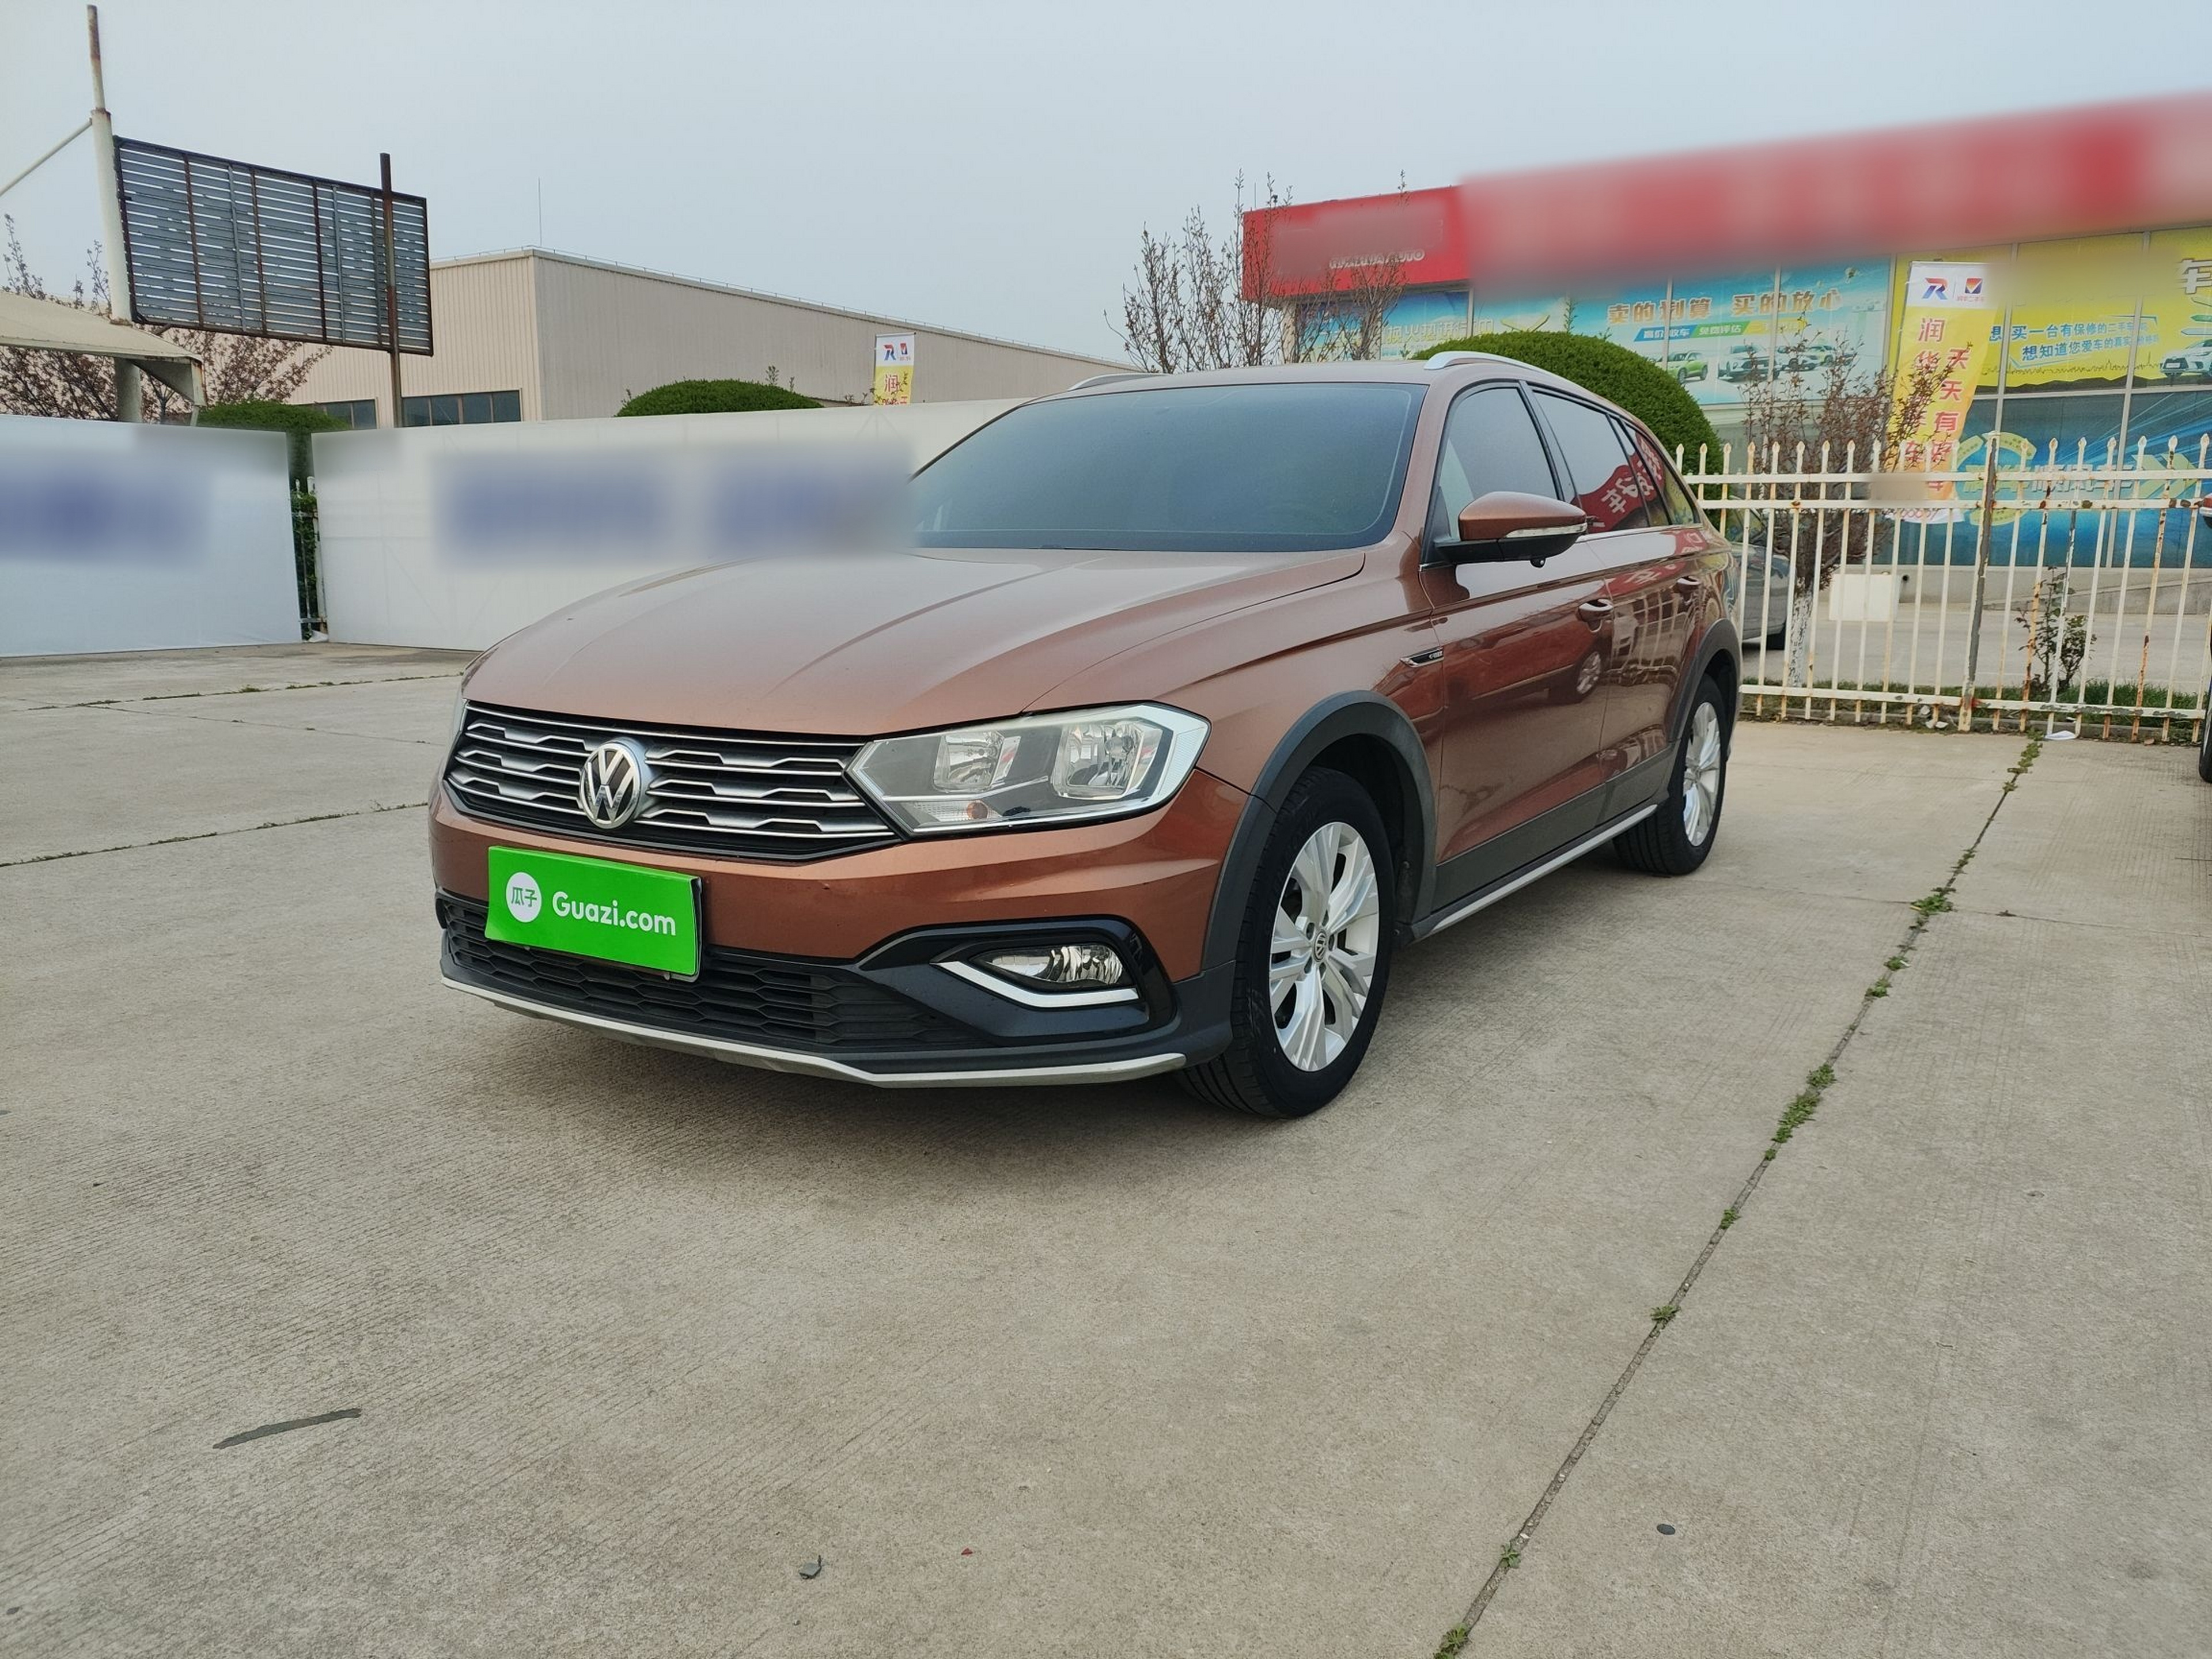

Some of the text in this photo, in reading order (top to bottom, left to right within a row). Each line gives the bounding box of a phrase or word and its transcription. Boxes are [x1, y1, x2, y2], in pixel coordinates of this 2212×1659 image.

[1608, 289, 1842, 324] 卖的划算 买的放心
[510, 888, 537, 908] 瓜子
[552, 891, 677, 937] Guazi.com
